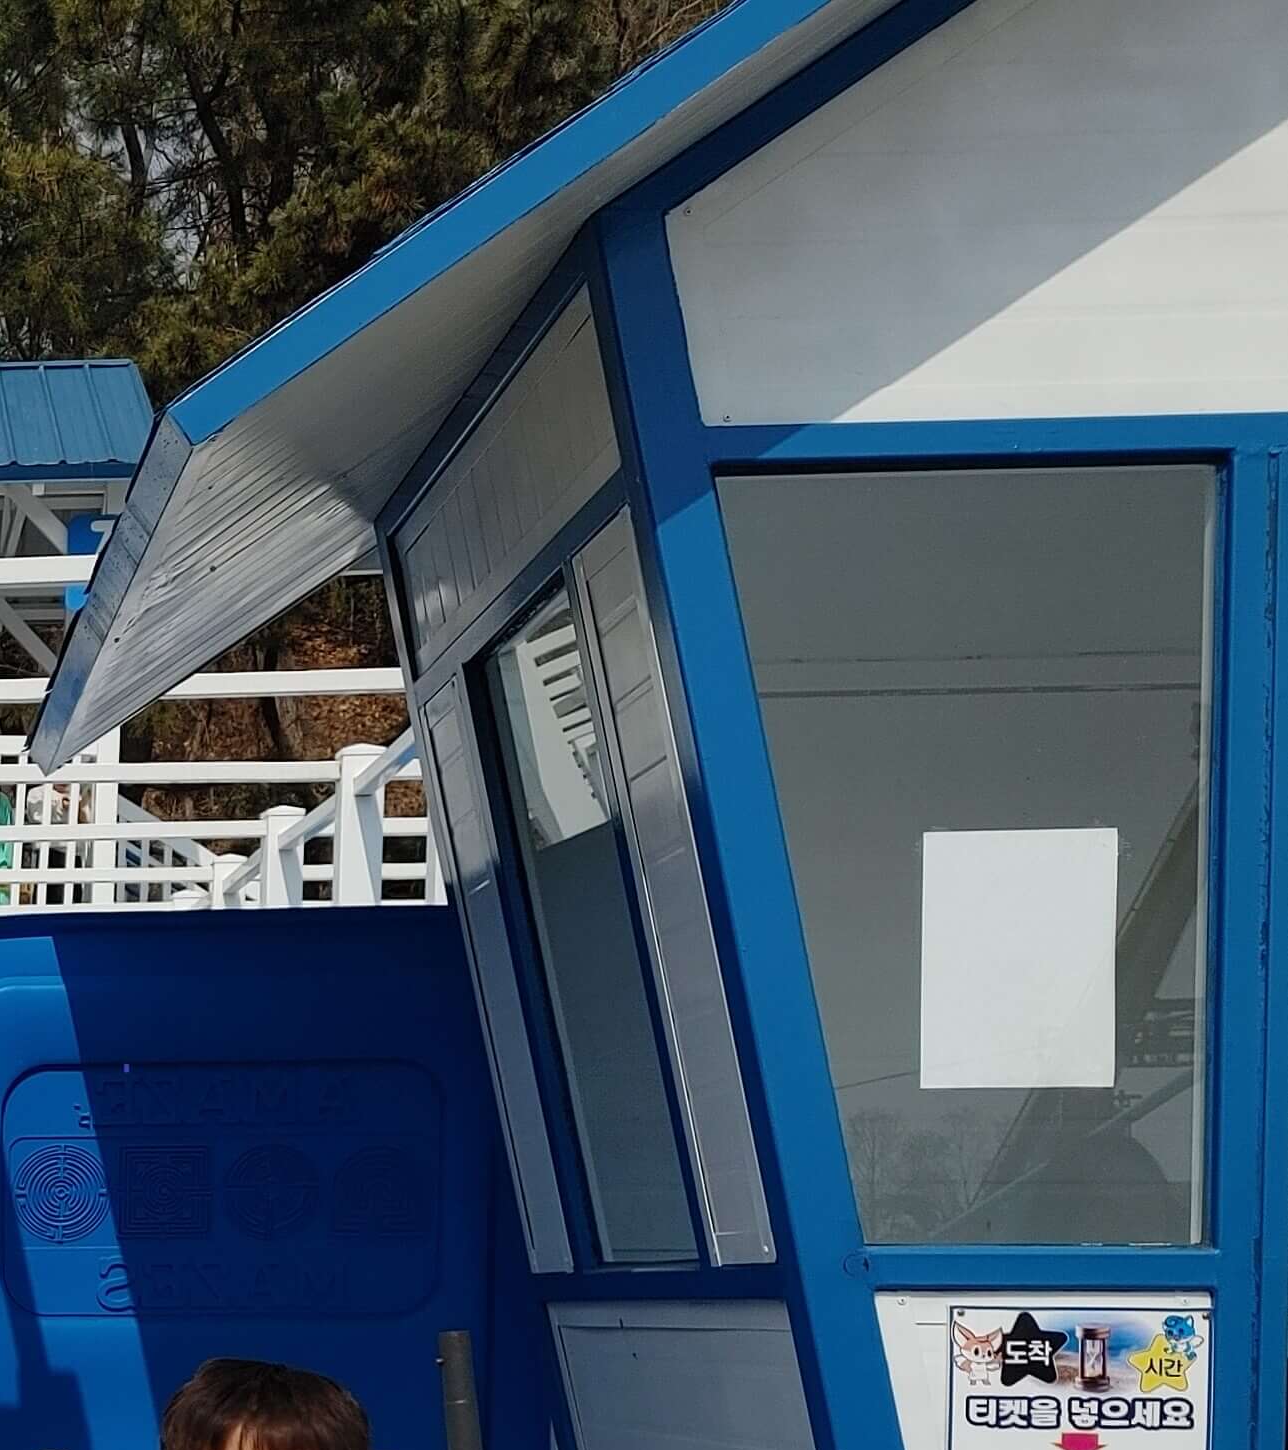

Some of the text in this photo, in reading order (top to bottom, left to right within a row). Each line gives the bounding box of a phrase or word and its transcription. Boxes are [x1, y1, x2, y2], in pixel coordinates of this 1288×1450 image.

[1005, 1340, 1053, 1367] 도착
[1144, 1358, 1183, 1378] 시간
[967, 1397, 1194, 1430] 티켓을 넣으세요
